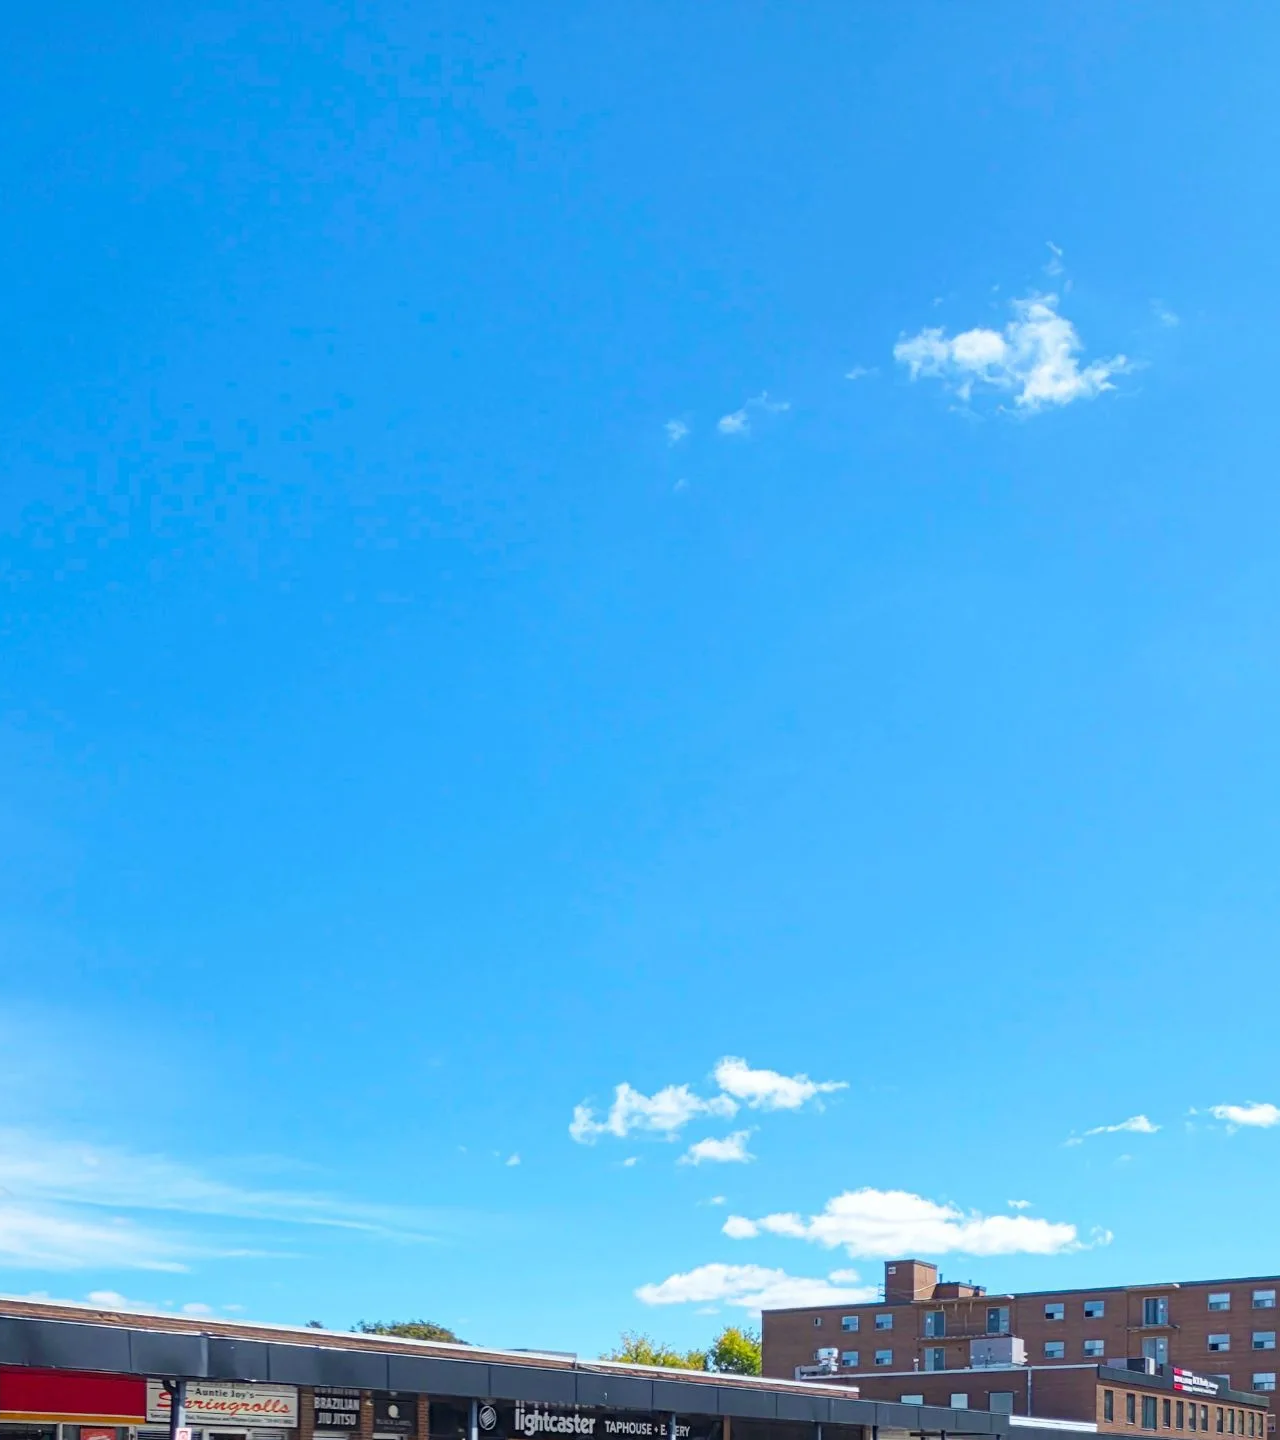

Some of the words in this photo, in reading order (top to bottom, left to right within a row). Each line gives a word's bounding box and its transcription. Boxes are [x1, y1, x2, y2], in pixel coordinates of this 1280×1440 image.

[195, 1388, 228, 1398] Auntie
[230, 1389, 256, 1400] Joy's
[314, 1397, 360, 1411] BRAZILIAN
[317, 1413, 331, 1425] JIU
[332, 1413, 357, 1426] JITSU
[514, 1407, 596, 1436] lightcaster
[604, 1420, 652, 1435] TAPHOUSE
[660, 1424, 691, 1437] EERY
